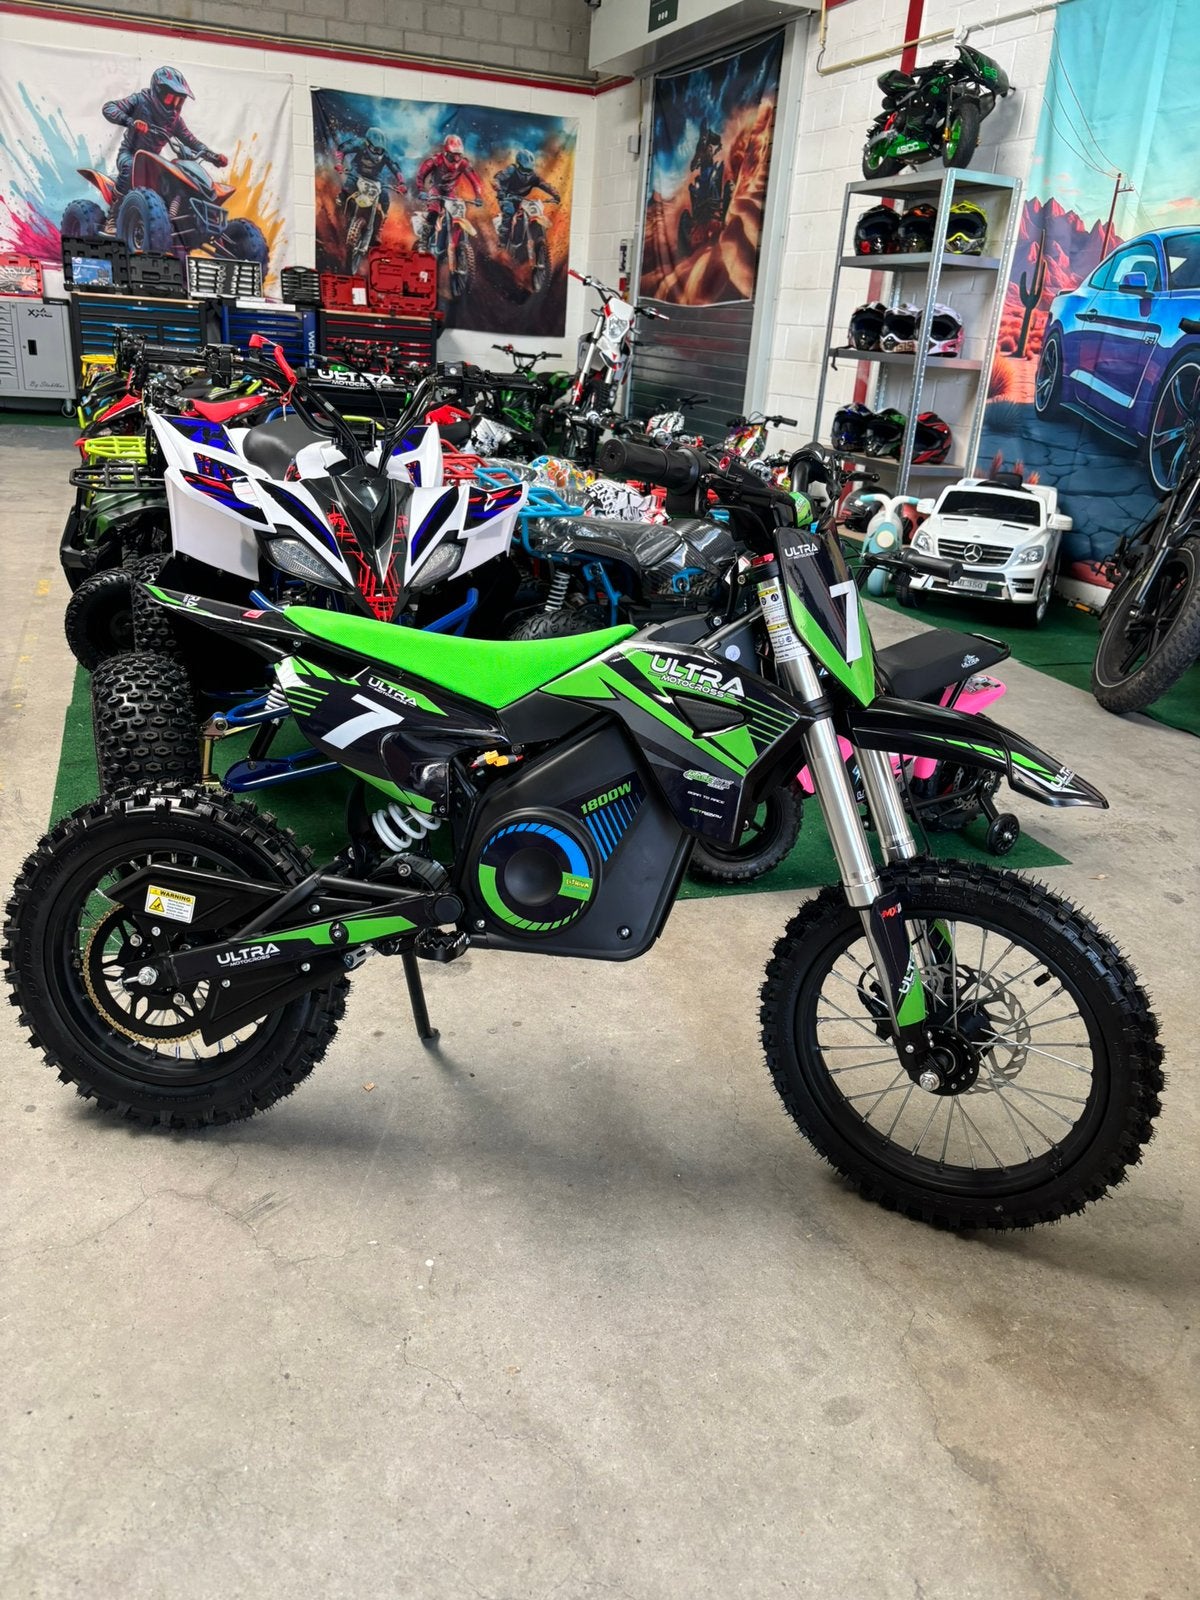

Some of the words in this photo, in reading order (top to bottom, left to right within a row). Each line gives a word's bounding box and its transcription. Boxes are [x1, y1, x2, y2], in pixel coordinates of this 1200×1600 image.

[896, 142, 920, 155] 49CC
[784, 543, 819, 558] ULTRA
[829, 580, 863, 663] 7
[651, 654, 745, 698] ULTRA
[661, 674, 725, 698] MOTOCROSS
[367, 677, 418, 707] ULTRA
[320, 693, 405, 750] 7
[581, 780, 632, 815] 1800W
[160, 890, 191, 903] WARNING
[216, 942, 281, 965] ULTRA
[229, 954, 271, 967] MOTOCROSS
